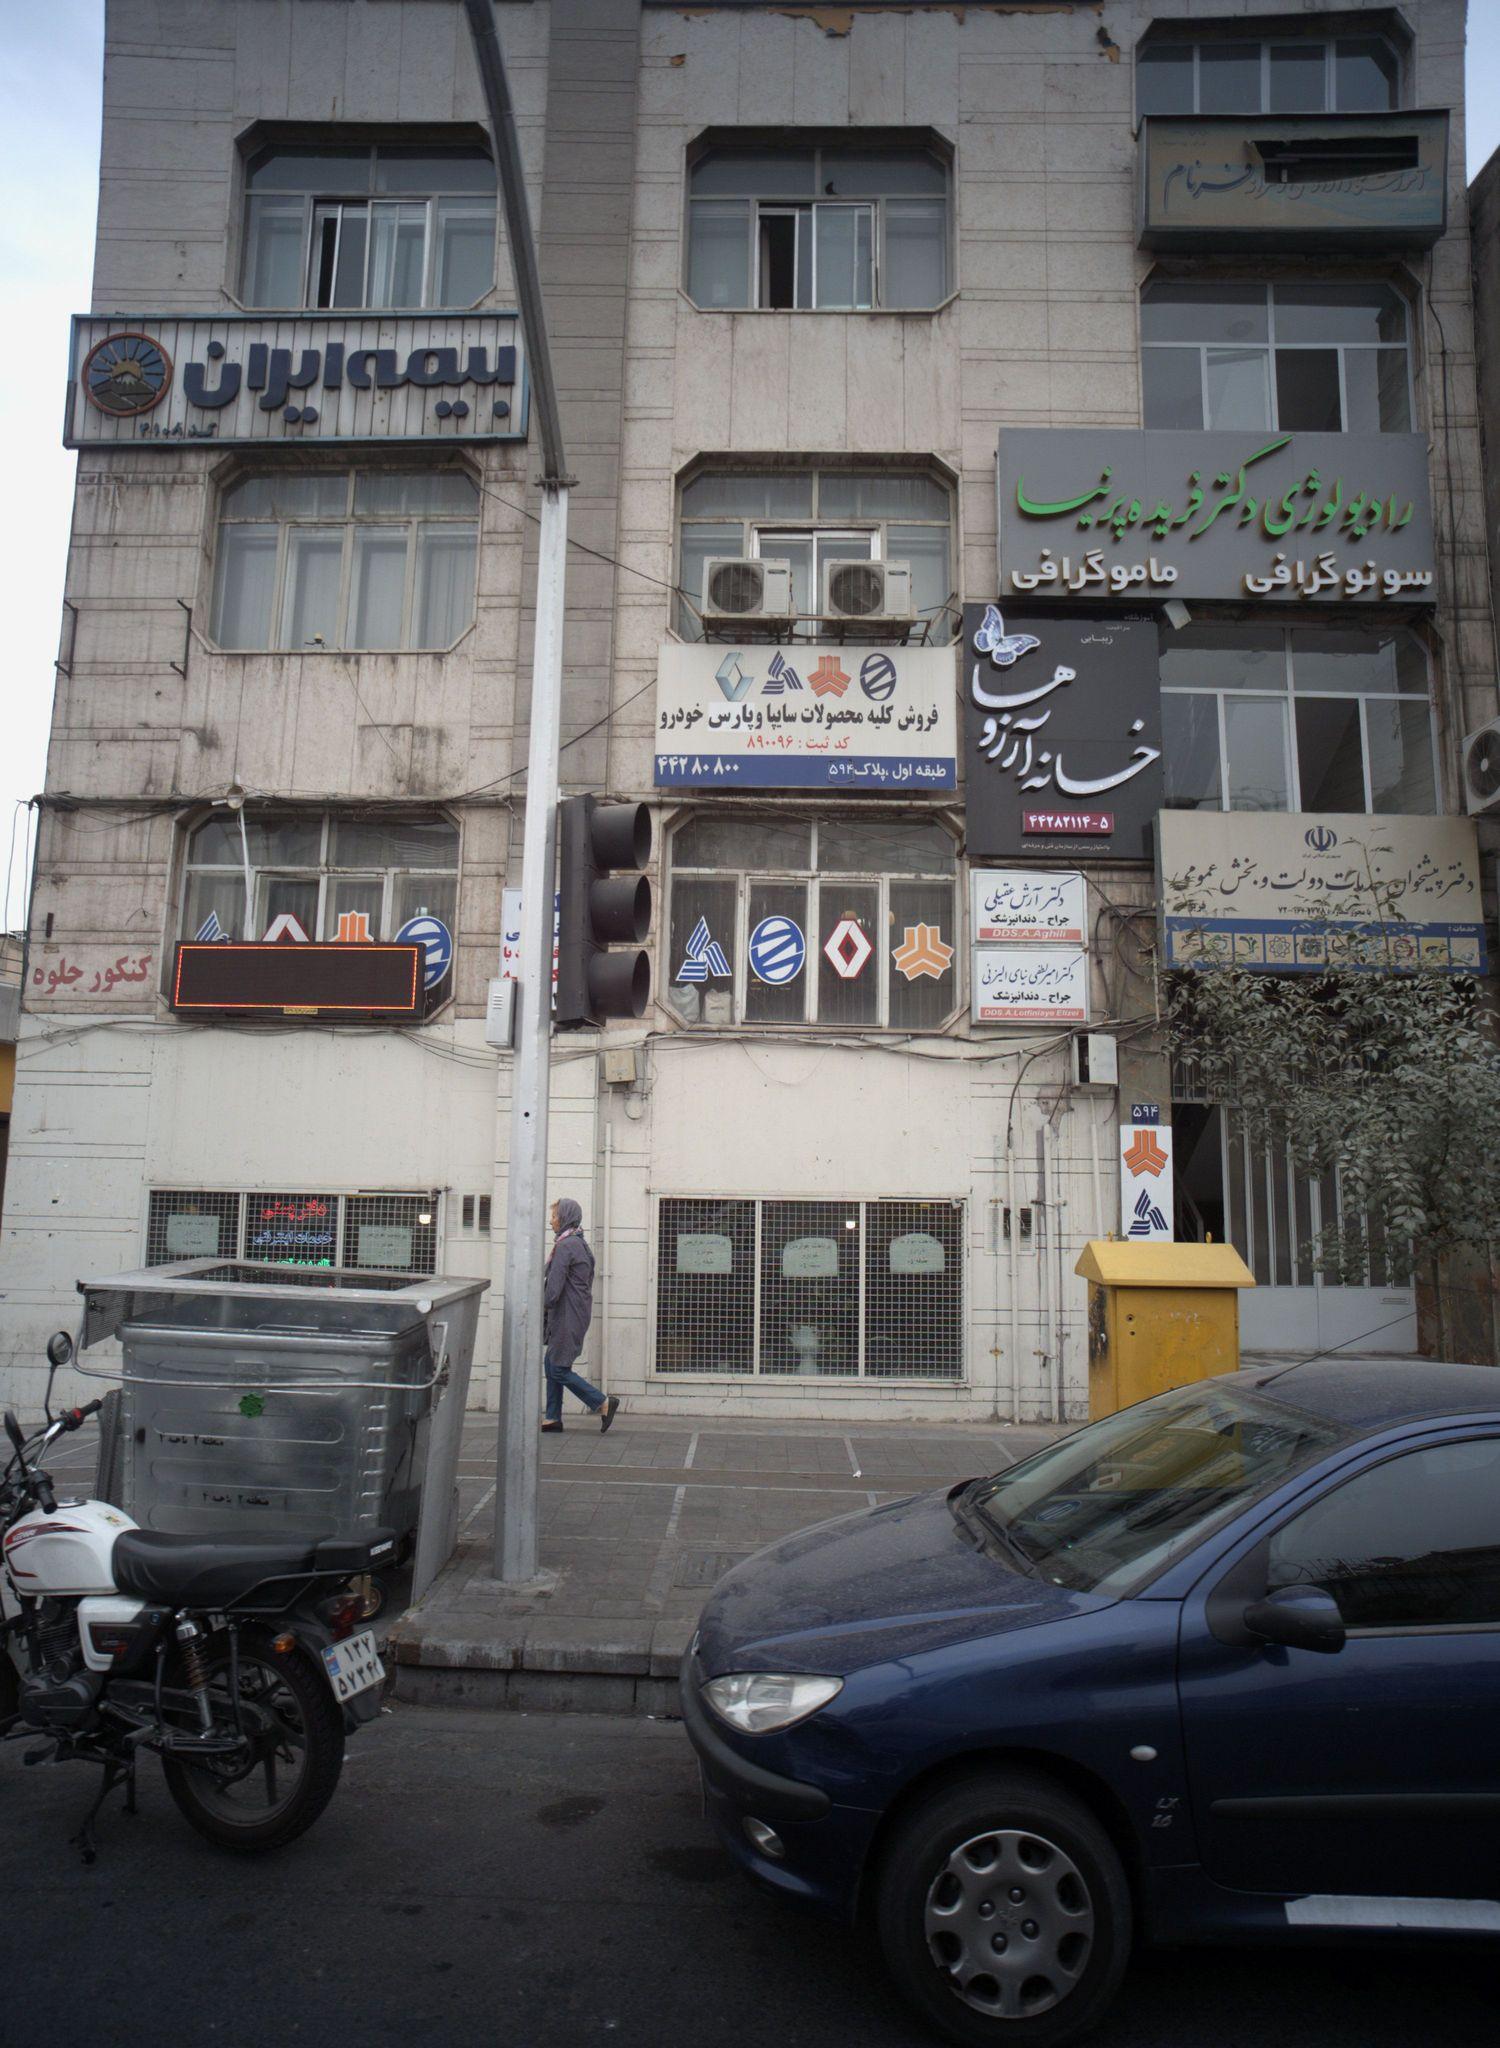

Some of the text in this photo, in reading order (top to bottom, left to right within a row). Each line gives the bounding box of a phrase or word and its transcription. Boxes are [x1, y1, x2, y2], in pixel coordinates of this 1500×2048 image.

[183, 341, 516, 423] بیمه ایران
[188, 422, 218, 438] کد
[1016, 434, 1414, 538] رادیولوژی دکتر فریده پرنیا
[1011, 548, 1433, 596] سونوگرافی ماموگرافی
[1080, 632, 1114, 645] زیبایی
[659, 702, 704, 730] خودرو
[767, 702, 798, 730] سایپا
[801, 703, 864, 732] محصولات
[867, 704, 894, 730] کلیه
[897, 703, 939, 732] فروش
[806, 735, 830, 752] ثبت
[833, 736, 851, 750] کد
[892, 763, 913, 780] اول
[915, 763, 947, 779] طبقه
[1220, 857, 1258, 895] بخش
[1260, 877, 1269, 890] و
[1271, 868, 1324, 891] دولت
[1387, 854, 1446, 899] پیشخوان
[1436, 861, 1475, 900] دفتر
[1009, 883, 1044, 910] آرش
[1039, 876, 1079, 912] دکتر
[990, 913, 1037, 927] دندانپزشک
[1047, 914, 1070, 926] جراح
[32, 955, 153, 994] کنکور جلوه
[1056, 956, 1083, 985] دکتر
[992, 991, 1040, 1004] دندانپزشک
[1048, 991, 1071, 1004] جراح
[1133, 1105, 1159, 1118] ۵۹۴
